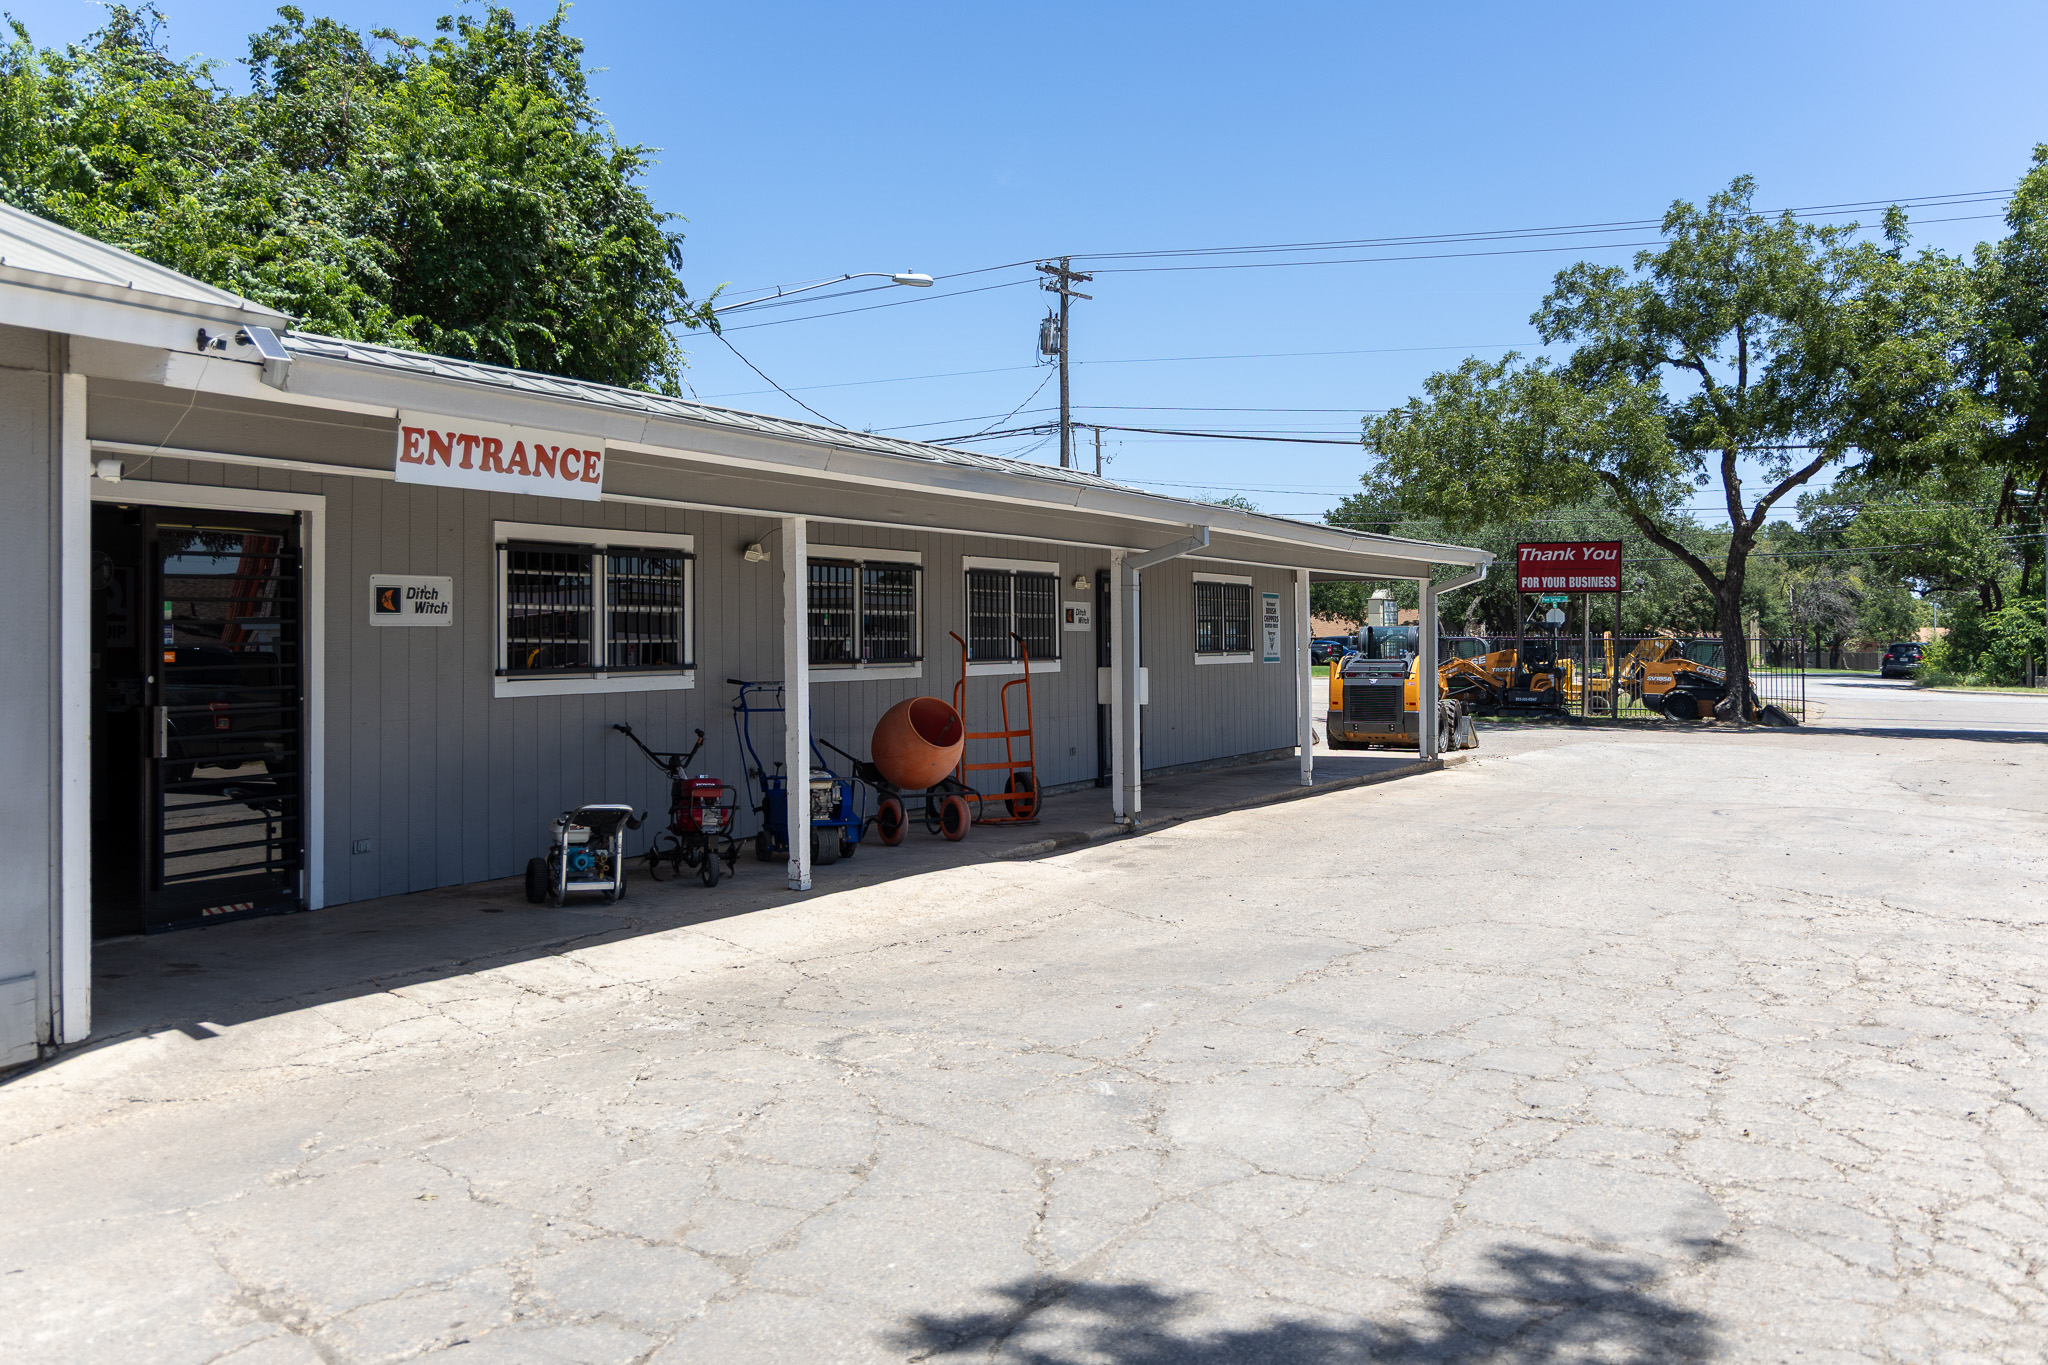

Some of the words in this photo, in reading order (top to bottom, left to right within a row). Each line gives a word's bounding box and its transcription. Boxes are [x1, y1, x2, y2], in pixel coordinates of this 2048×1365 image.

[400, 426, 601, 484] ENTRANCE
[1520, 547, 1576, 561] Thank
[1582, 547, 1618, 561] You
[1521, 576, 1540, 588] FOR
[1542, 576, 1566, 588] YOUR
[1569, 576, 1617, 588] BUSINESS
[406, 586, 439, 600] Ditch
[415, 601, 448, 614] Witch
[1076, 608, 1086, 616] Ditch
[1264, 615, 1279, 623] CHIPPERS
[1470, 655, 1486, 666] SE
[1695, 665, 1726, 679] CASE
